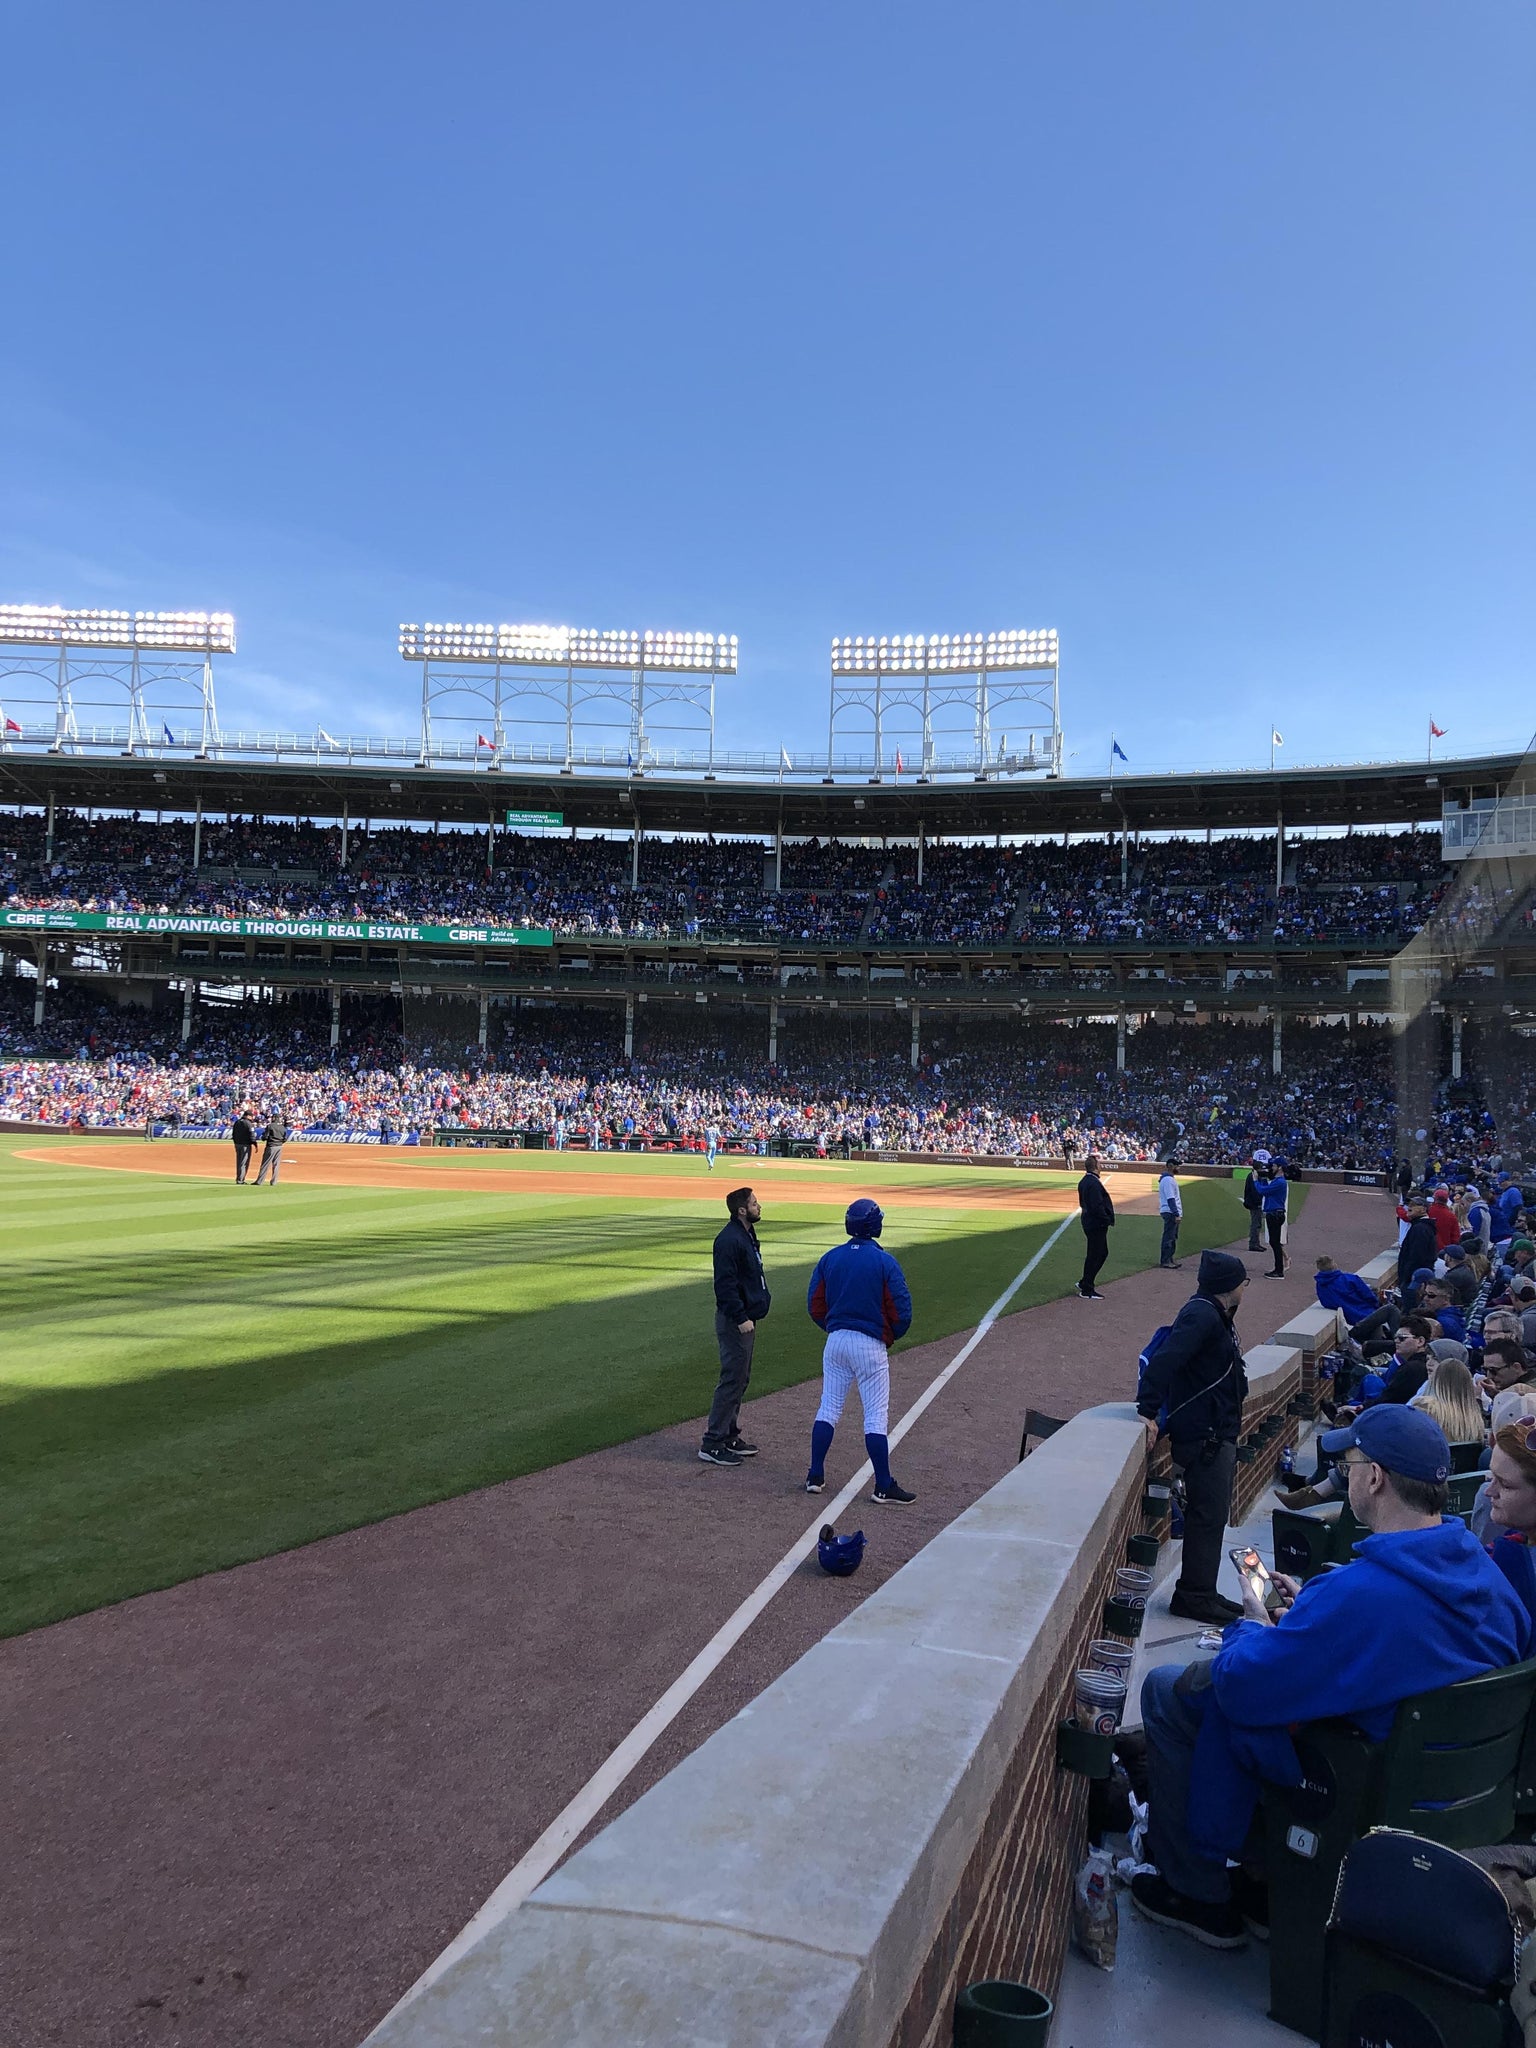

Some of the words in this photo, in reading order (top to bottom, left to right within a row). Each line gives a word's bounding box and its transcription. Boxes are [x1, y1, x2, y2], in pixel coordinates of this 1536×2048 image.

[6, 913, 46, 925] CBRE
[106, 916, 143, 930] REAL
[146, 917, 241, 933] ADVANTAGE
[244, 921, 323, 937] THROUGH
[327, 924, 364, 938] REAL
[368, 926, 424, 940] ESTATE.
[449, 929, 487, 941] CBRE
[287, 1130, 348, 1143] Reynolds
[1297, 1834, 1305, 1848] 6
